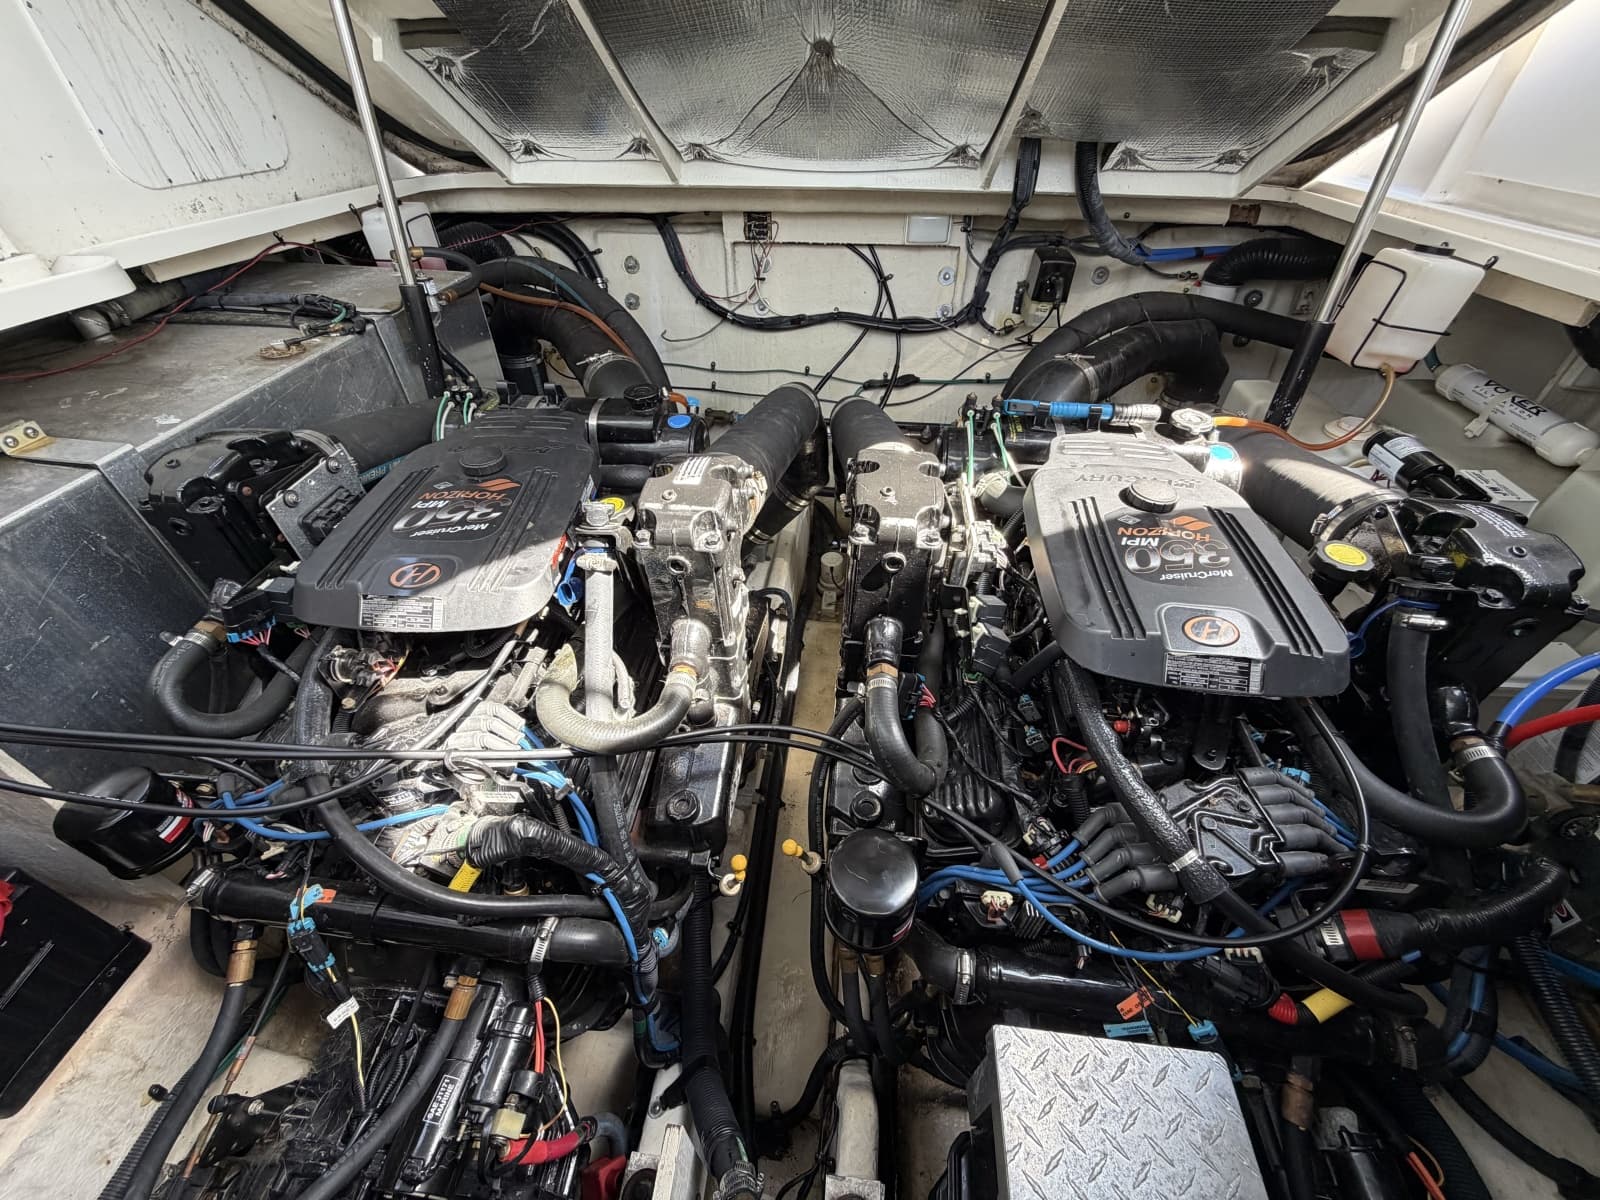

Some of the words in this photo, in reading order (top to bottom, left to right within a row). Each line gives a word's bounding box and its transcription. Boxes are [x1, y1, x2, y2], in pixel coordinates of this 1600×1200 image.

[1472, 384, 1534, 418] FILTATION
[418, 489, 506, 500] HORIZON
[410, 499, 450, 509] MPI
[392, 498, 513, 531] 350
[409, 523, 489, 538] MerCruiser
[1117, 526, 1211, 542] HORIZON
[1120, 536, 1160, 547] MPI
[1124, 540, 1231, 574] 350
[1159, 569, 1234, 581] MerCruiser
[435, 1083, 454, 1117] MARINE
